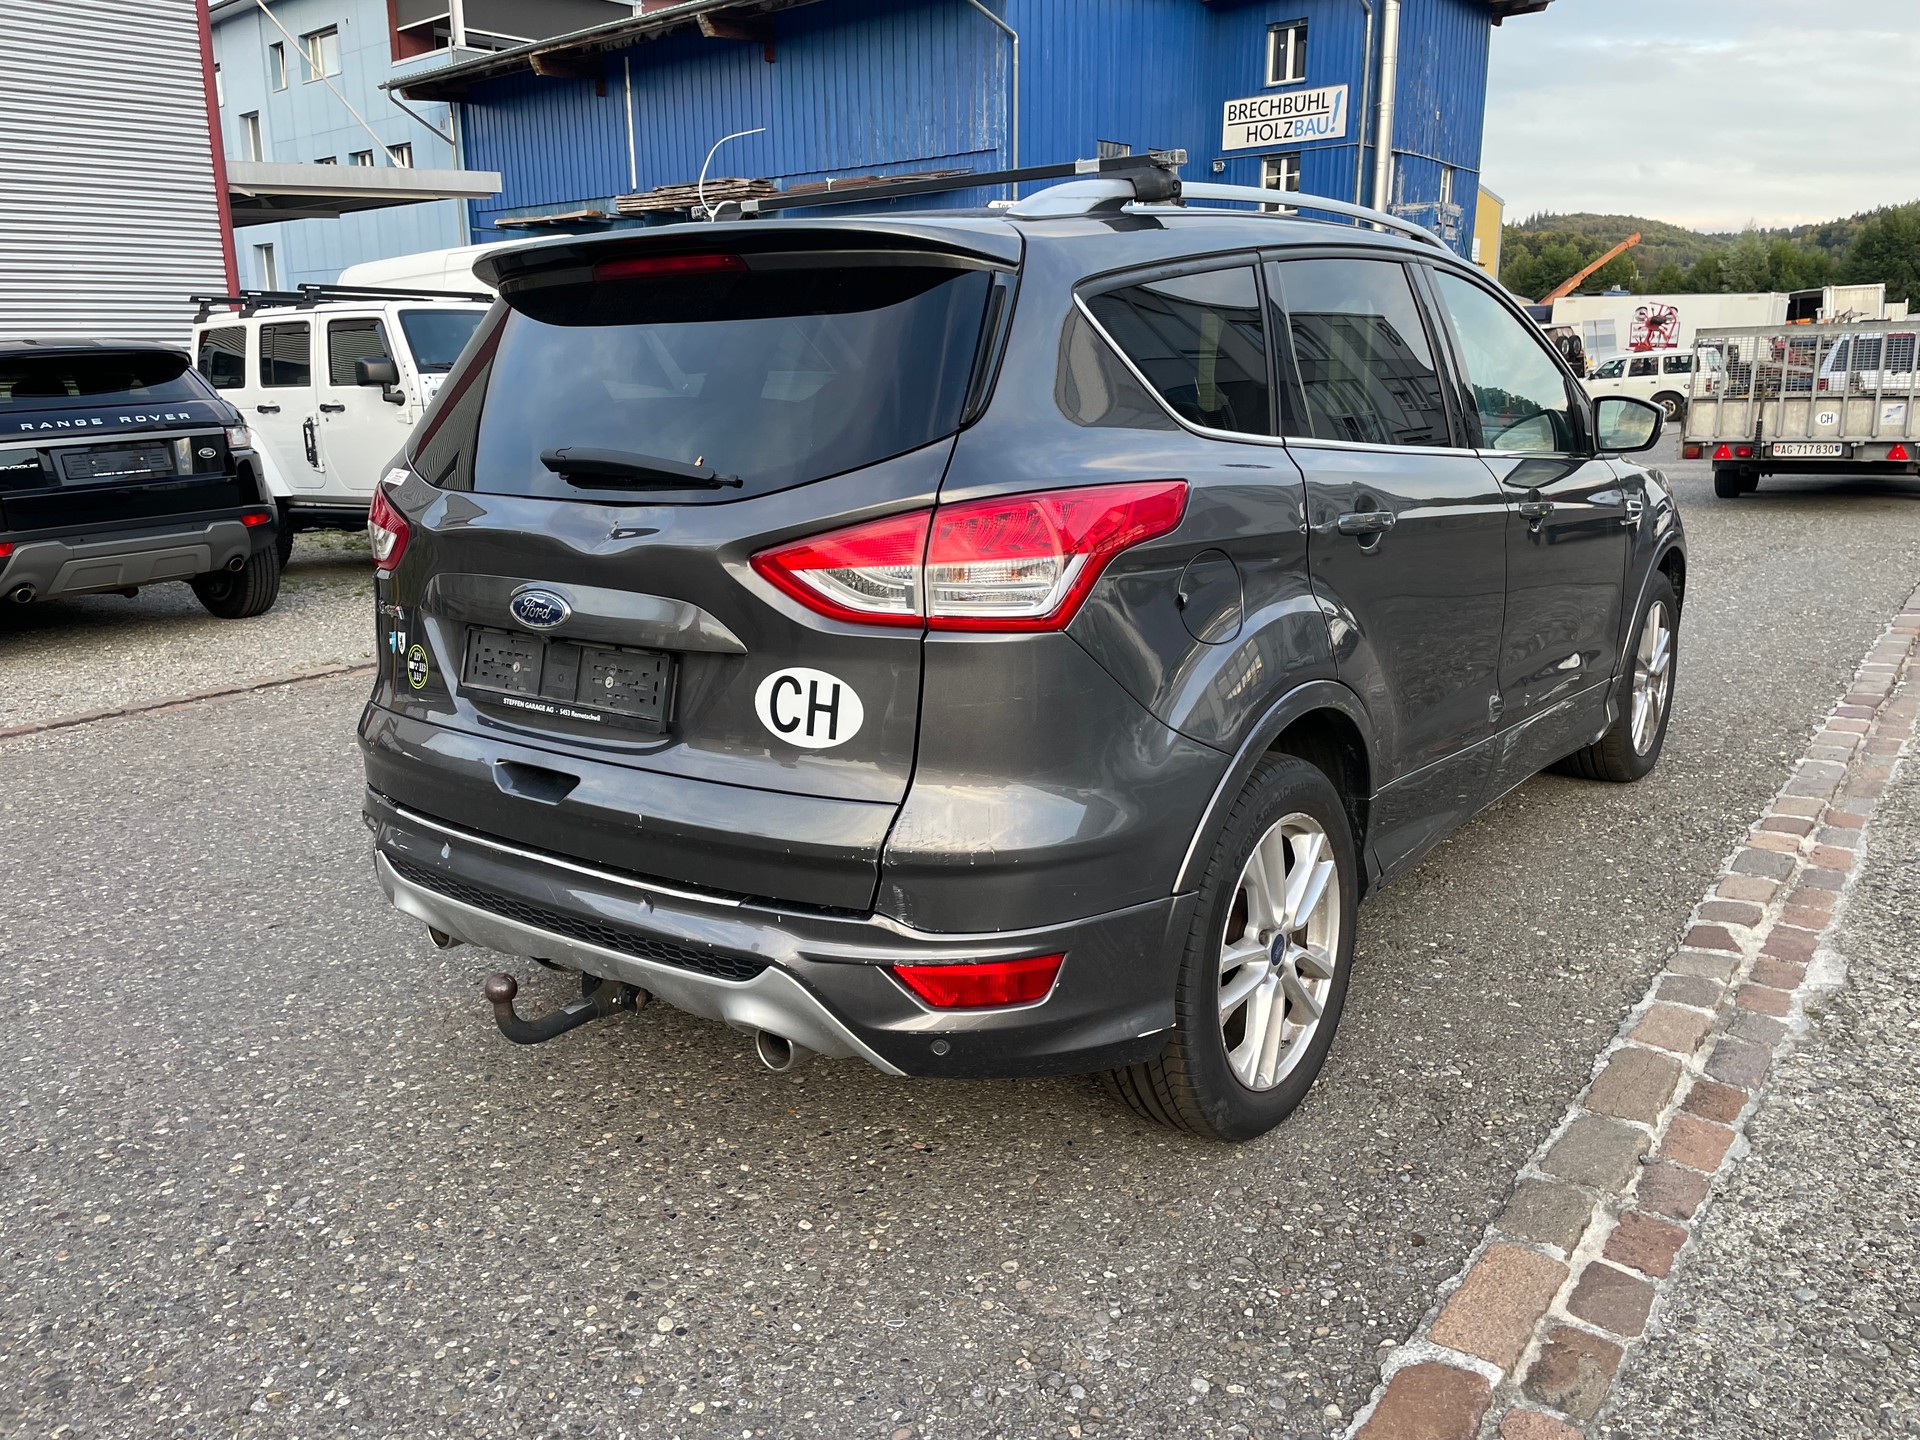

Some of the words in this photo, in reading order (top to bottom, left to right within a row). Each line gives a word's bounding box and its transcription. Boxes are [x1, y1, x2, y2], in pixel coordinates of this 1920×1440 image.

[1227, 91, 1330, 122] BRECHBÜHL
[20, 417, 104, 431] RANGE
[119, 412, 191, 424] ROVER
[1820, 413, 1834, 424] CH
[520, 596, 553, 620] Ford
[503, 697, 525, 708] STEFFEN
[524, 701, 546, 712] GARAGE
[545, 705, 554, 714] AG
[769, 675, 841, 741] CH
